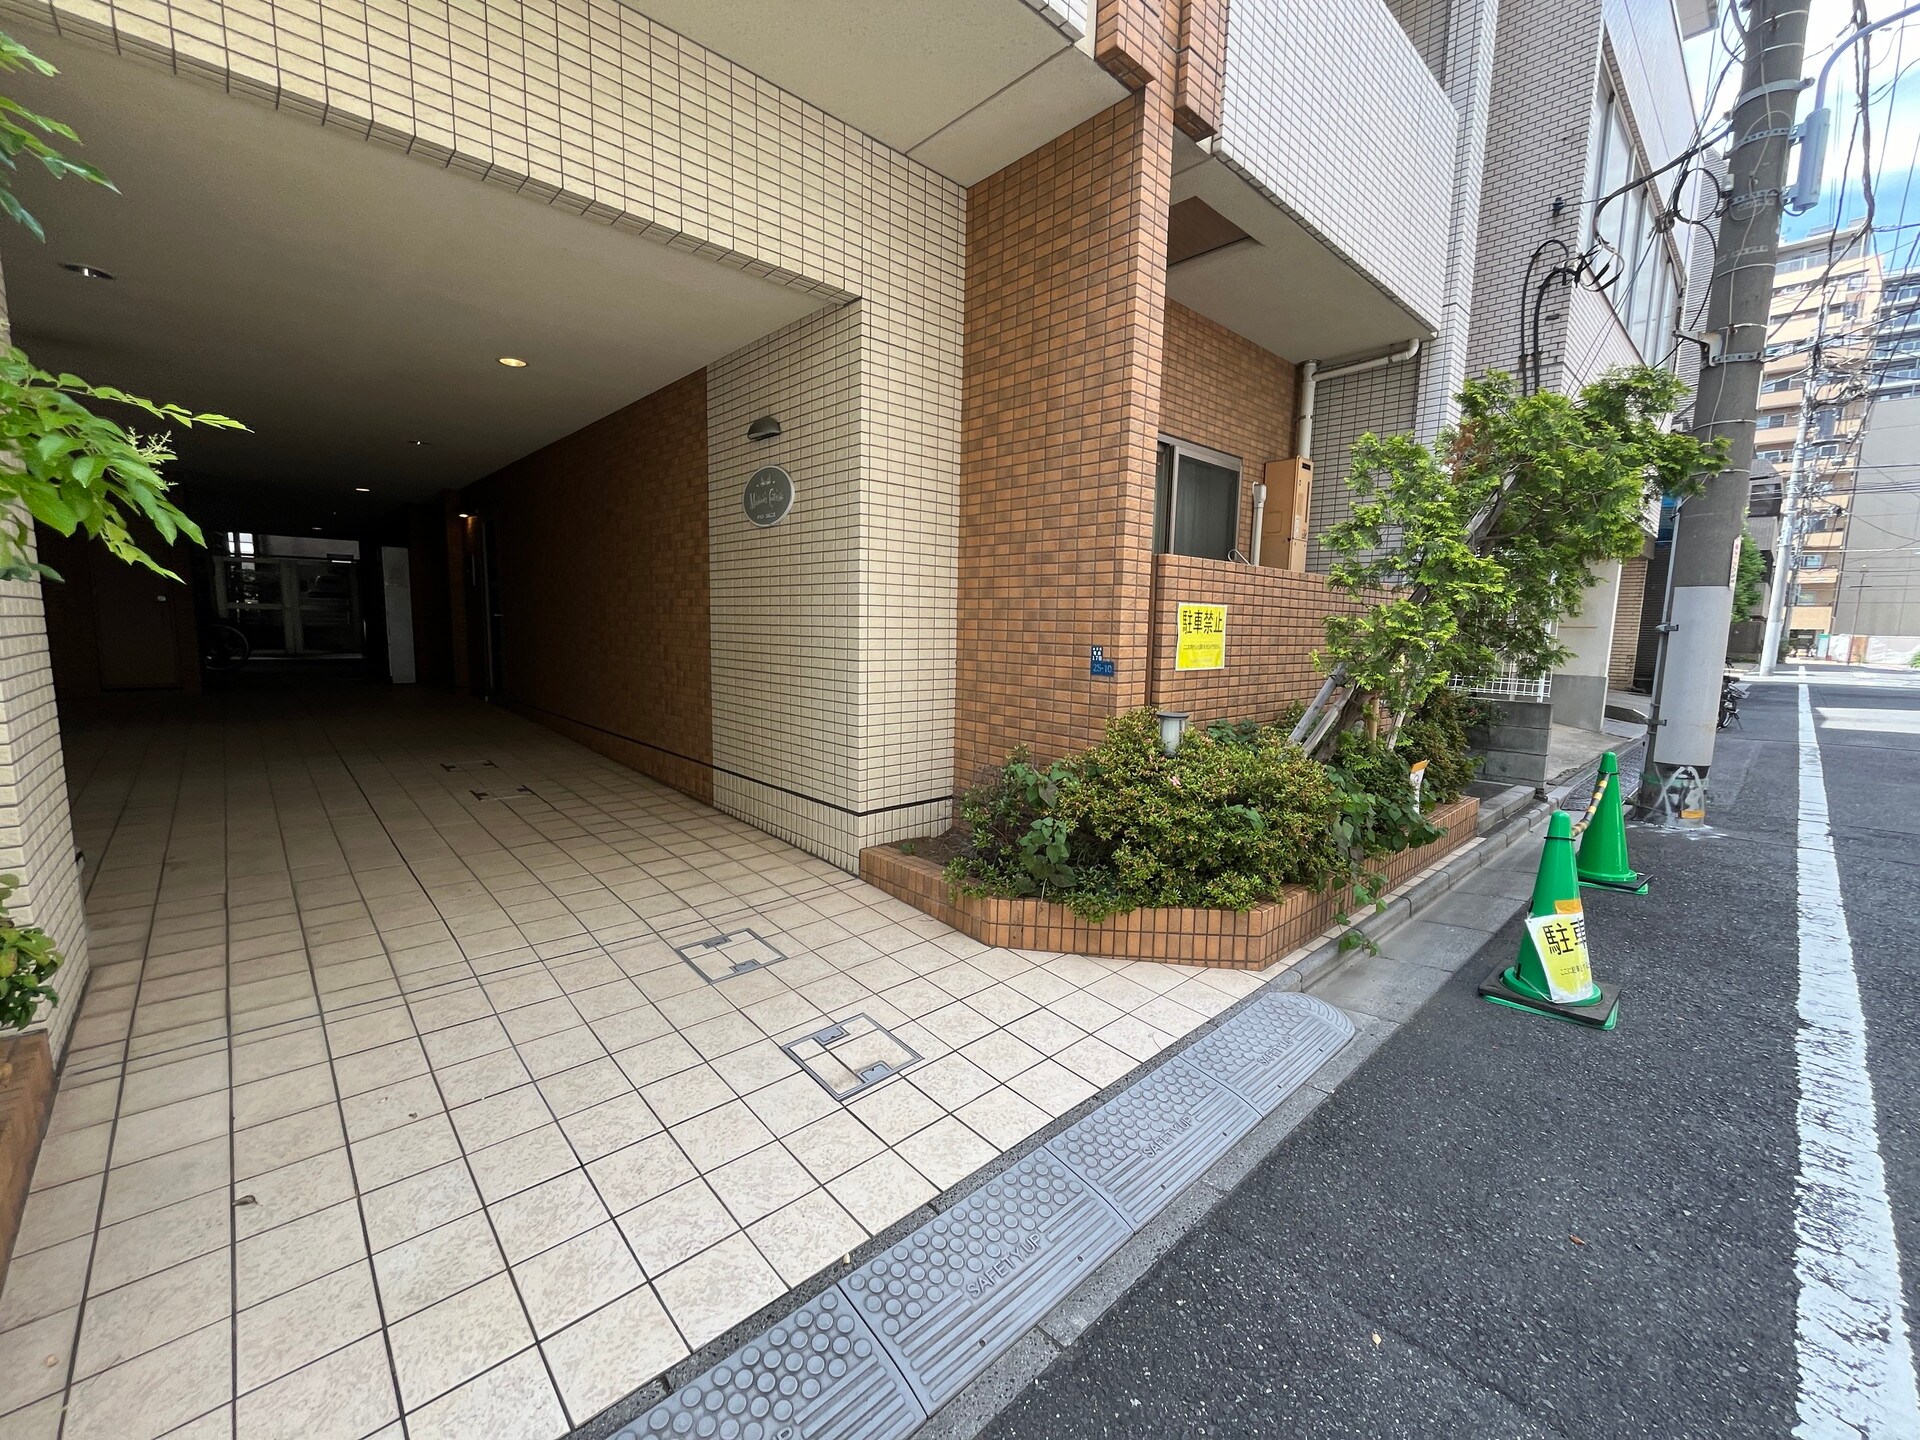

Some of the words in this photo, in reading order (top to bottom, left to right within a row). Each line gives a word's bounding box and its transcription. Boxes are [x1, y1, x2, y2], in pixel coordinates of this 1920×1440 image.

[1182, 609, 1223, 635] 駐車禁止
[1542, 917, 1586, 956] 駐車
